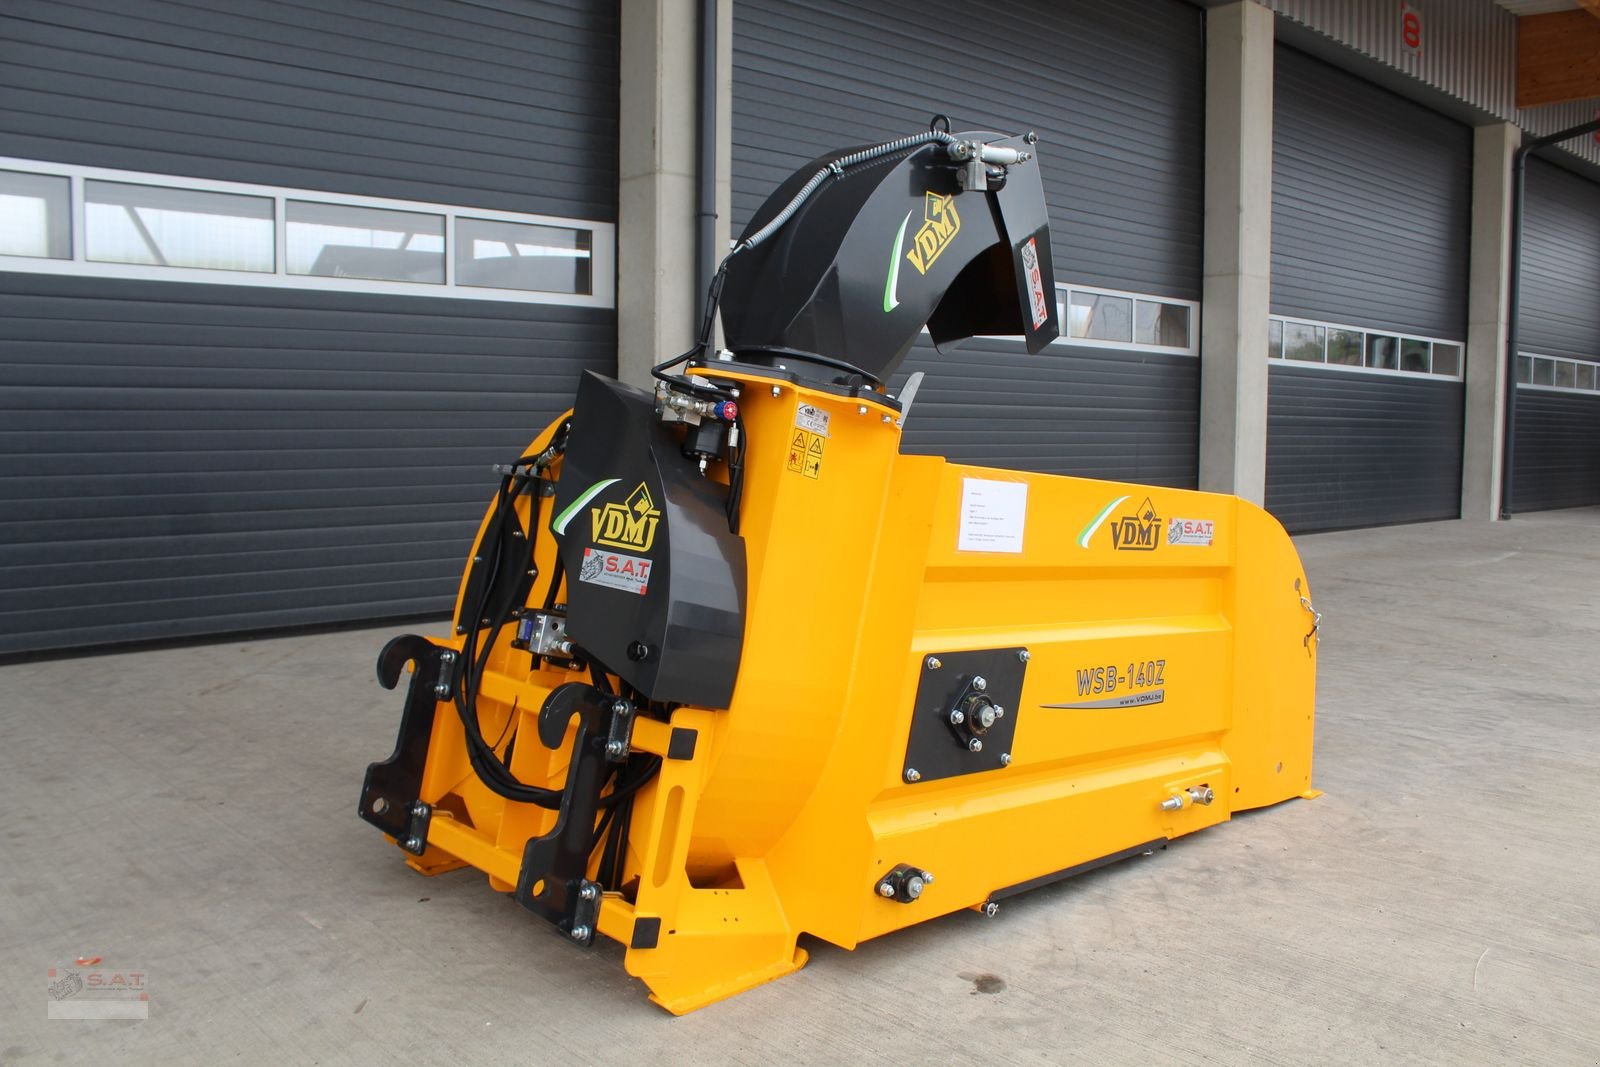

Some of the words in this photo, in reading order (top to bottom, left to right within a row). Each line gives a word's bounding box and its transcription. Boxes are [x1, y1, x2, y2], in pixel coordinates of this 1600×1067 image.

[1403, 11, 1421, 48] 8
[906, 193, 961, 276] VDMJ
[1030, 268, 1047, 323] S.A.T.
[591, 502, 661, 553] VDMJ
[1111, 516, 1162, 551] VDMJ
[1184, 521, 1213, 535] S.A.T.
[605, 555, 651, 579] S.A.T.
[1076, 660, 1166, 697] WSB-140Z
[1119, 694, 1162, 706] www.VDMJ.be
